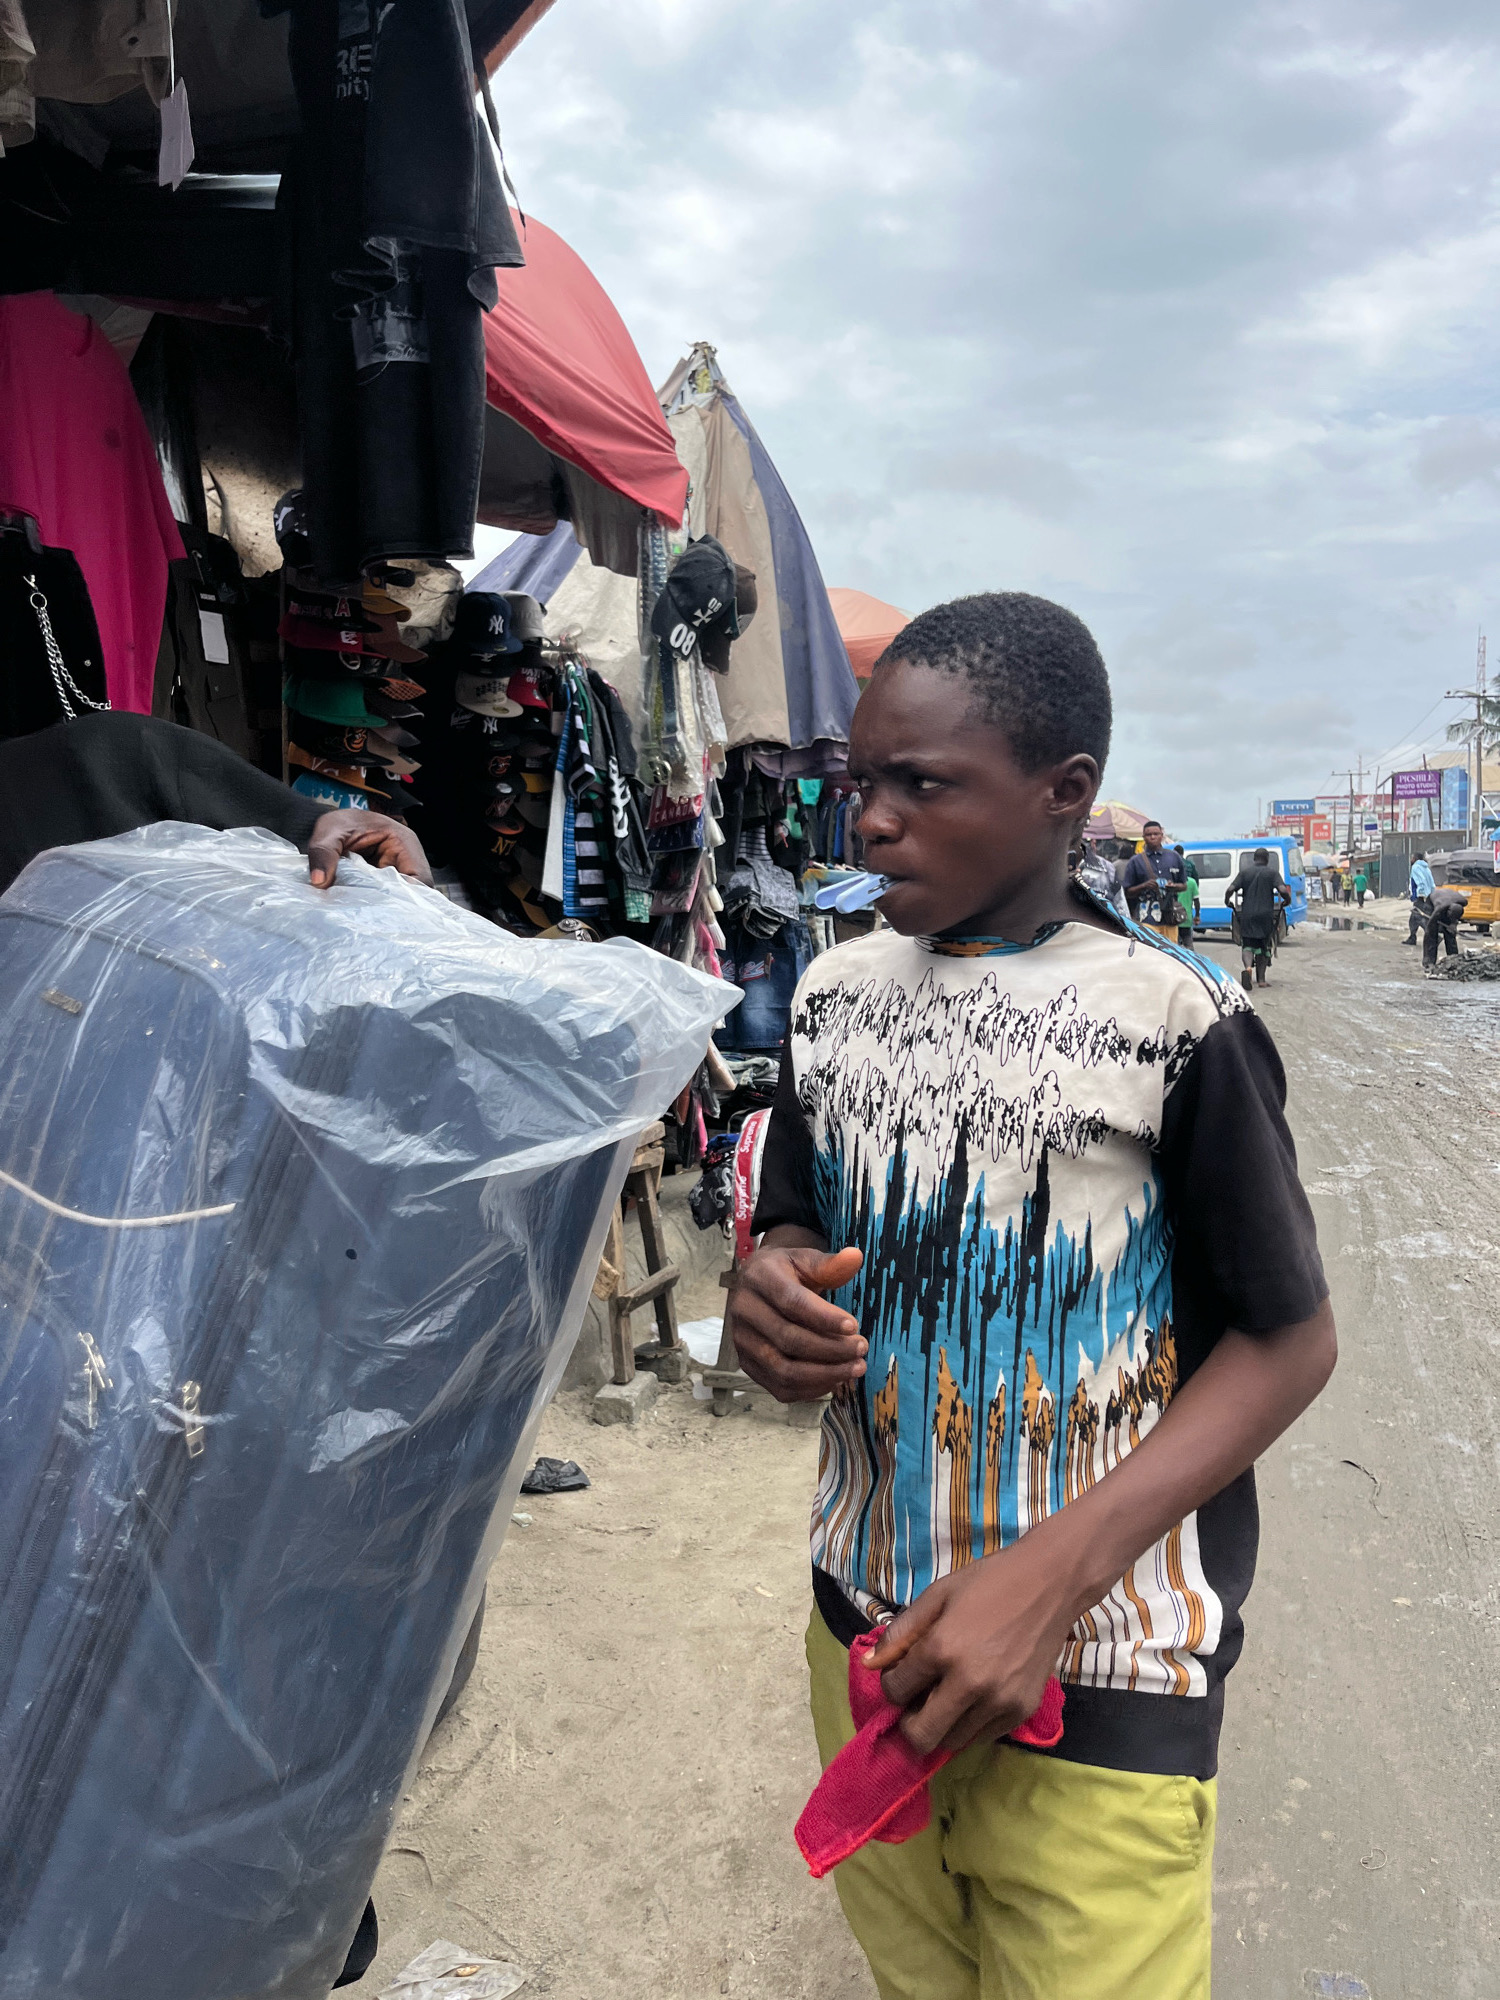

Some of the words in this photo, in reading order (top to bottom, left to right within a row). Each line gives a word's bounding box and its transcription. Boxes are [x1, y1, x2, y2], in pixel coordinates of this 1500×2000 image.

[707, 597, 722, 613] 08
[488, 615, 504, 635] NY
[670, 623, 697, 656] 08
[483, 717, 498, 734] NY
[740, 1120, 758, 1153] Supreme
[735, 1175, 748, 1220] Supreme
